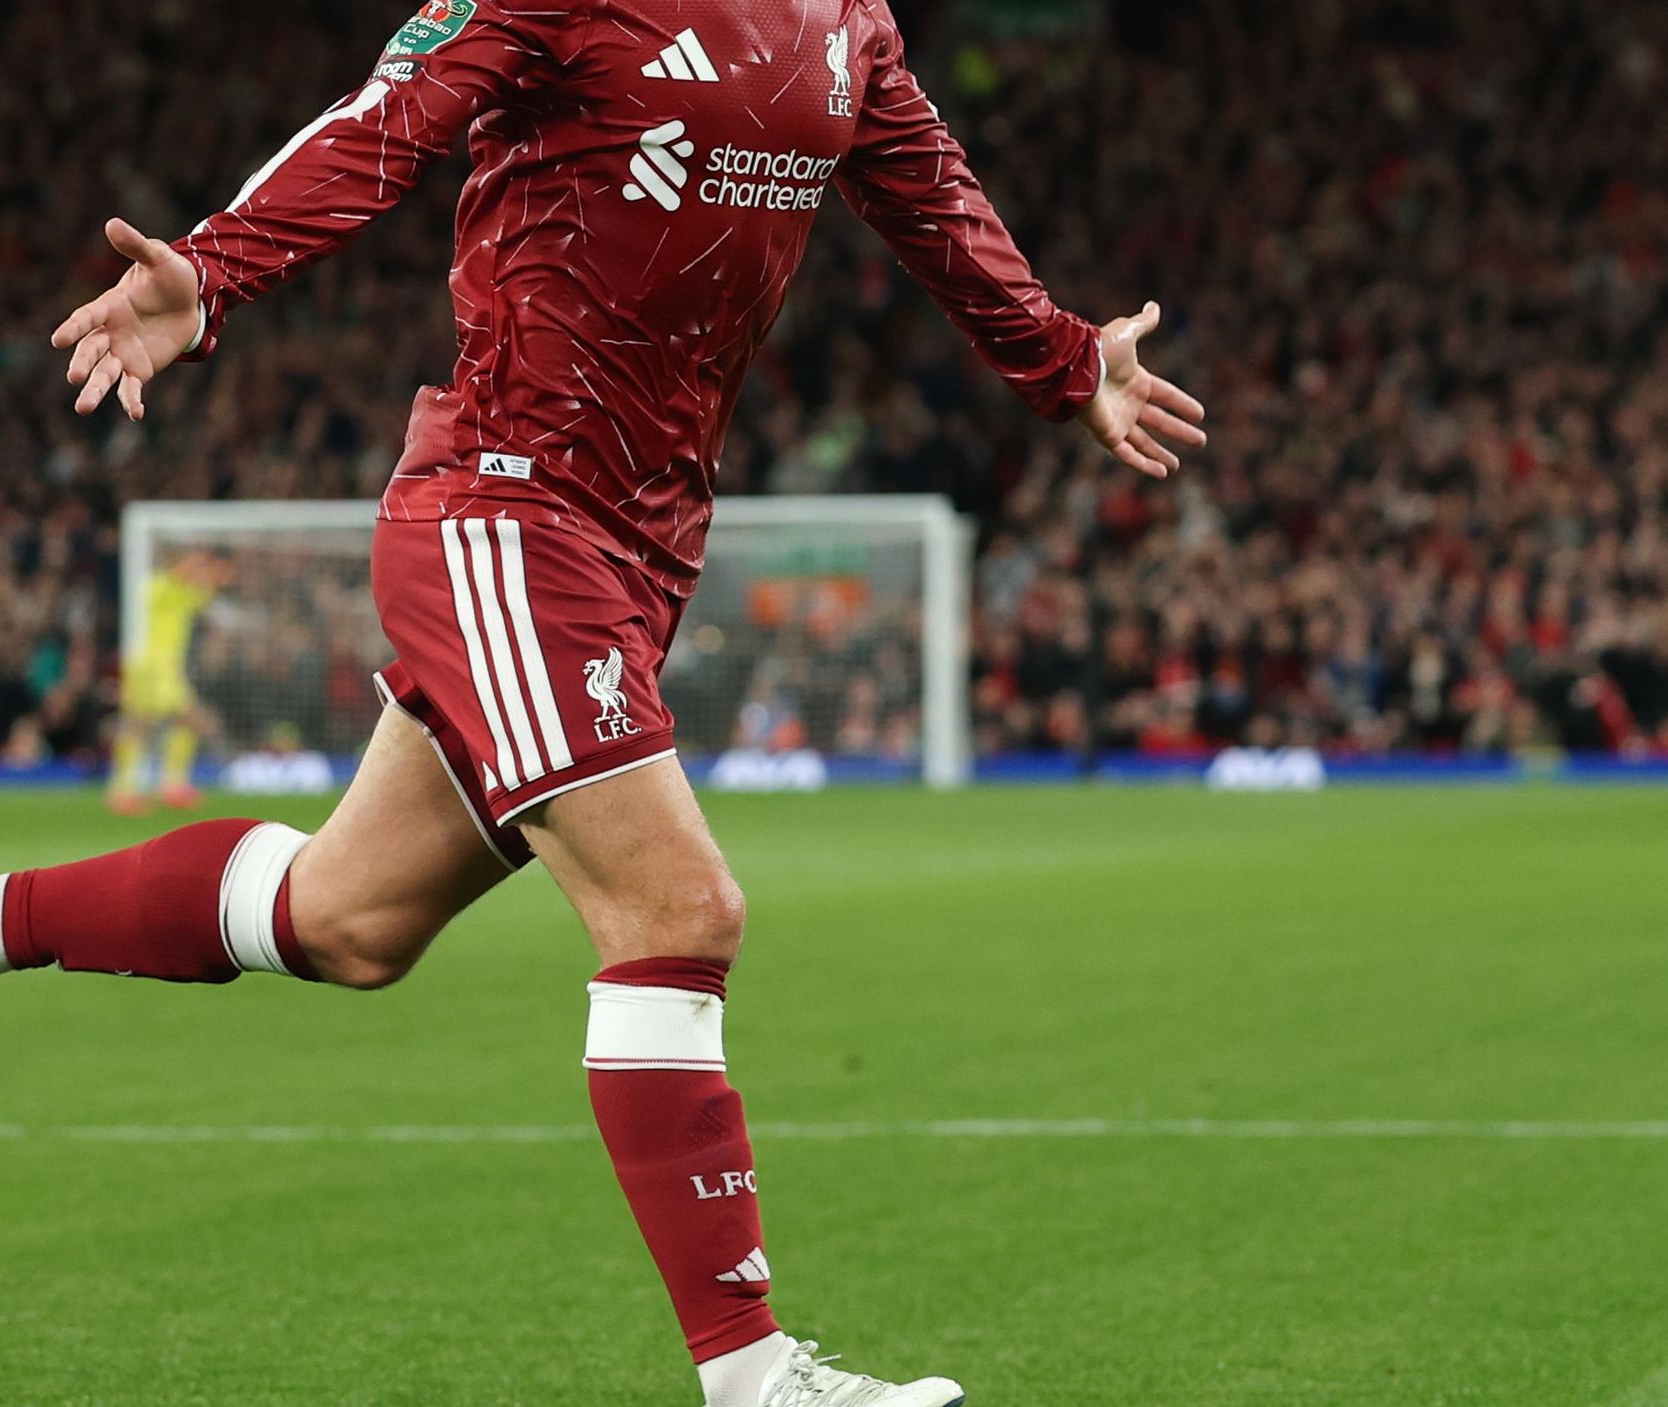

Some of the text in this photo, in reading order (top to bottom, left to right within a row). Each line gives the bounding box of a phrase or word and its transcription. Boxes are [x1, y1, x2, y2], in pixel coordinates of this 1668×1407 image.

[403, 23, 430, 39] Cup
[706, 142, 841, 180] standard
[699, 175, 827, 211] chartered
[689, 1170, 757, 1199] LFC
